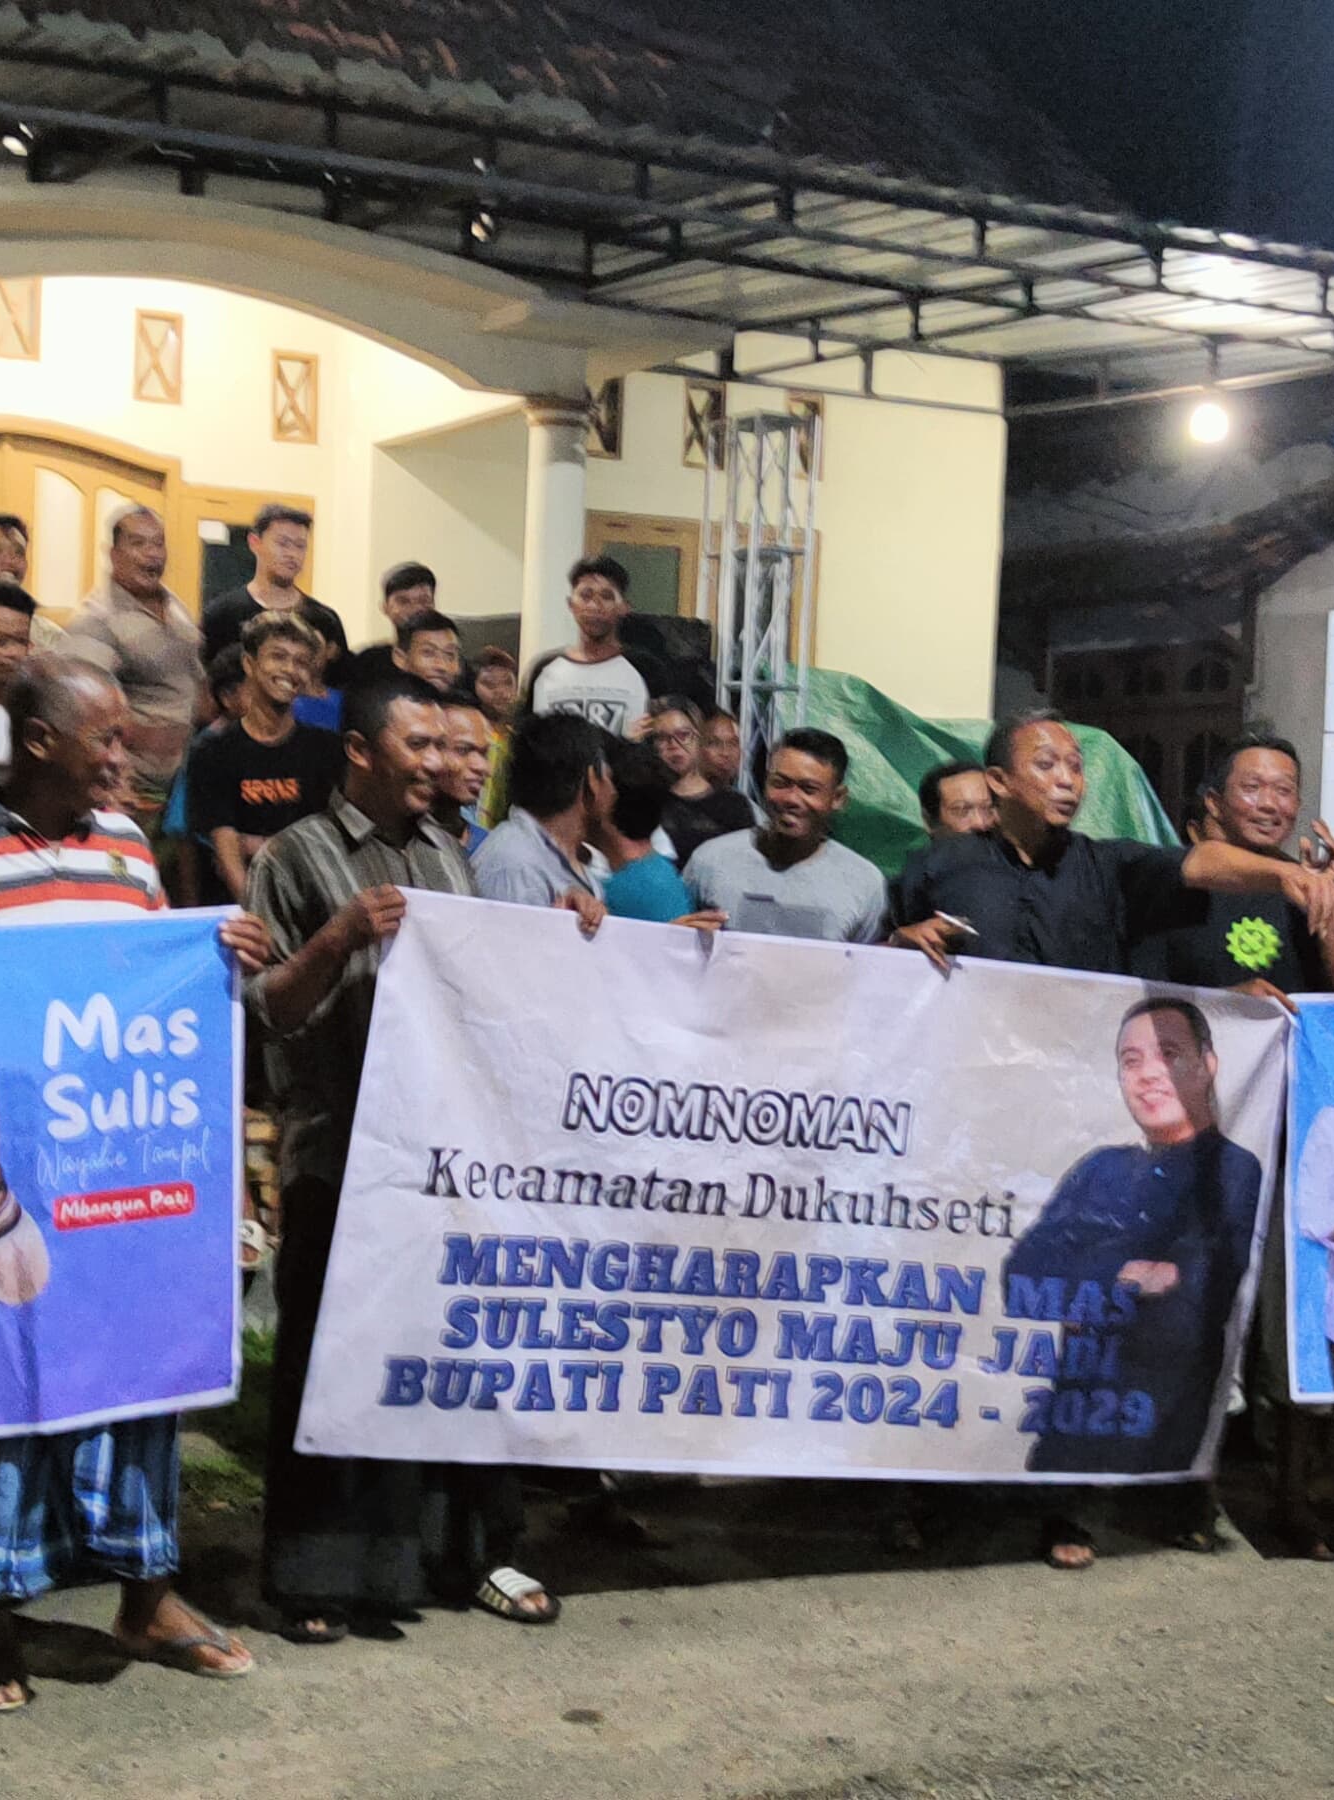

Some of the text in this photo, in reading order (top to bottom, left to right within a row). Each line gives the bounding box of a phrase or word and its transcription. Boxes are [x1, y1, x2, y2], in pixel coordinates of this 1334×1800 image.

[43, 992, 200, 1070] Mas
[43, 1069, 201, 1140] Sulis
[562, 1071, 913, 1157] NOMNOMAN
[60, 1189, 189, 1222] Mbangun Pati
[421, 1146, 1016, 1239] Kecamatan Dukuhseti
[436, 1231, 1141, 1328] MENGHARAPKAN MAS
[440, 1295, 1119, 1381] SULESTYO MAJU JADI
[377, 1355, 1157, 1438] BUPATI PATI 2024 - 2029
